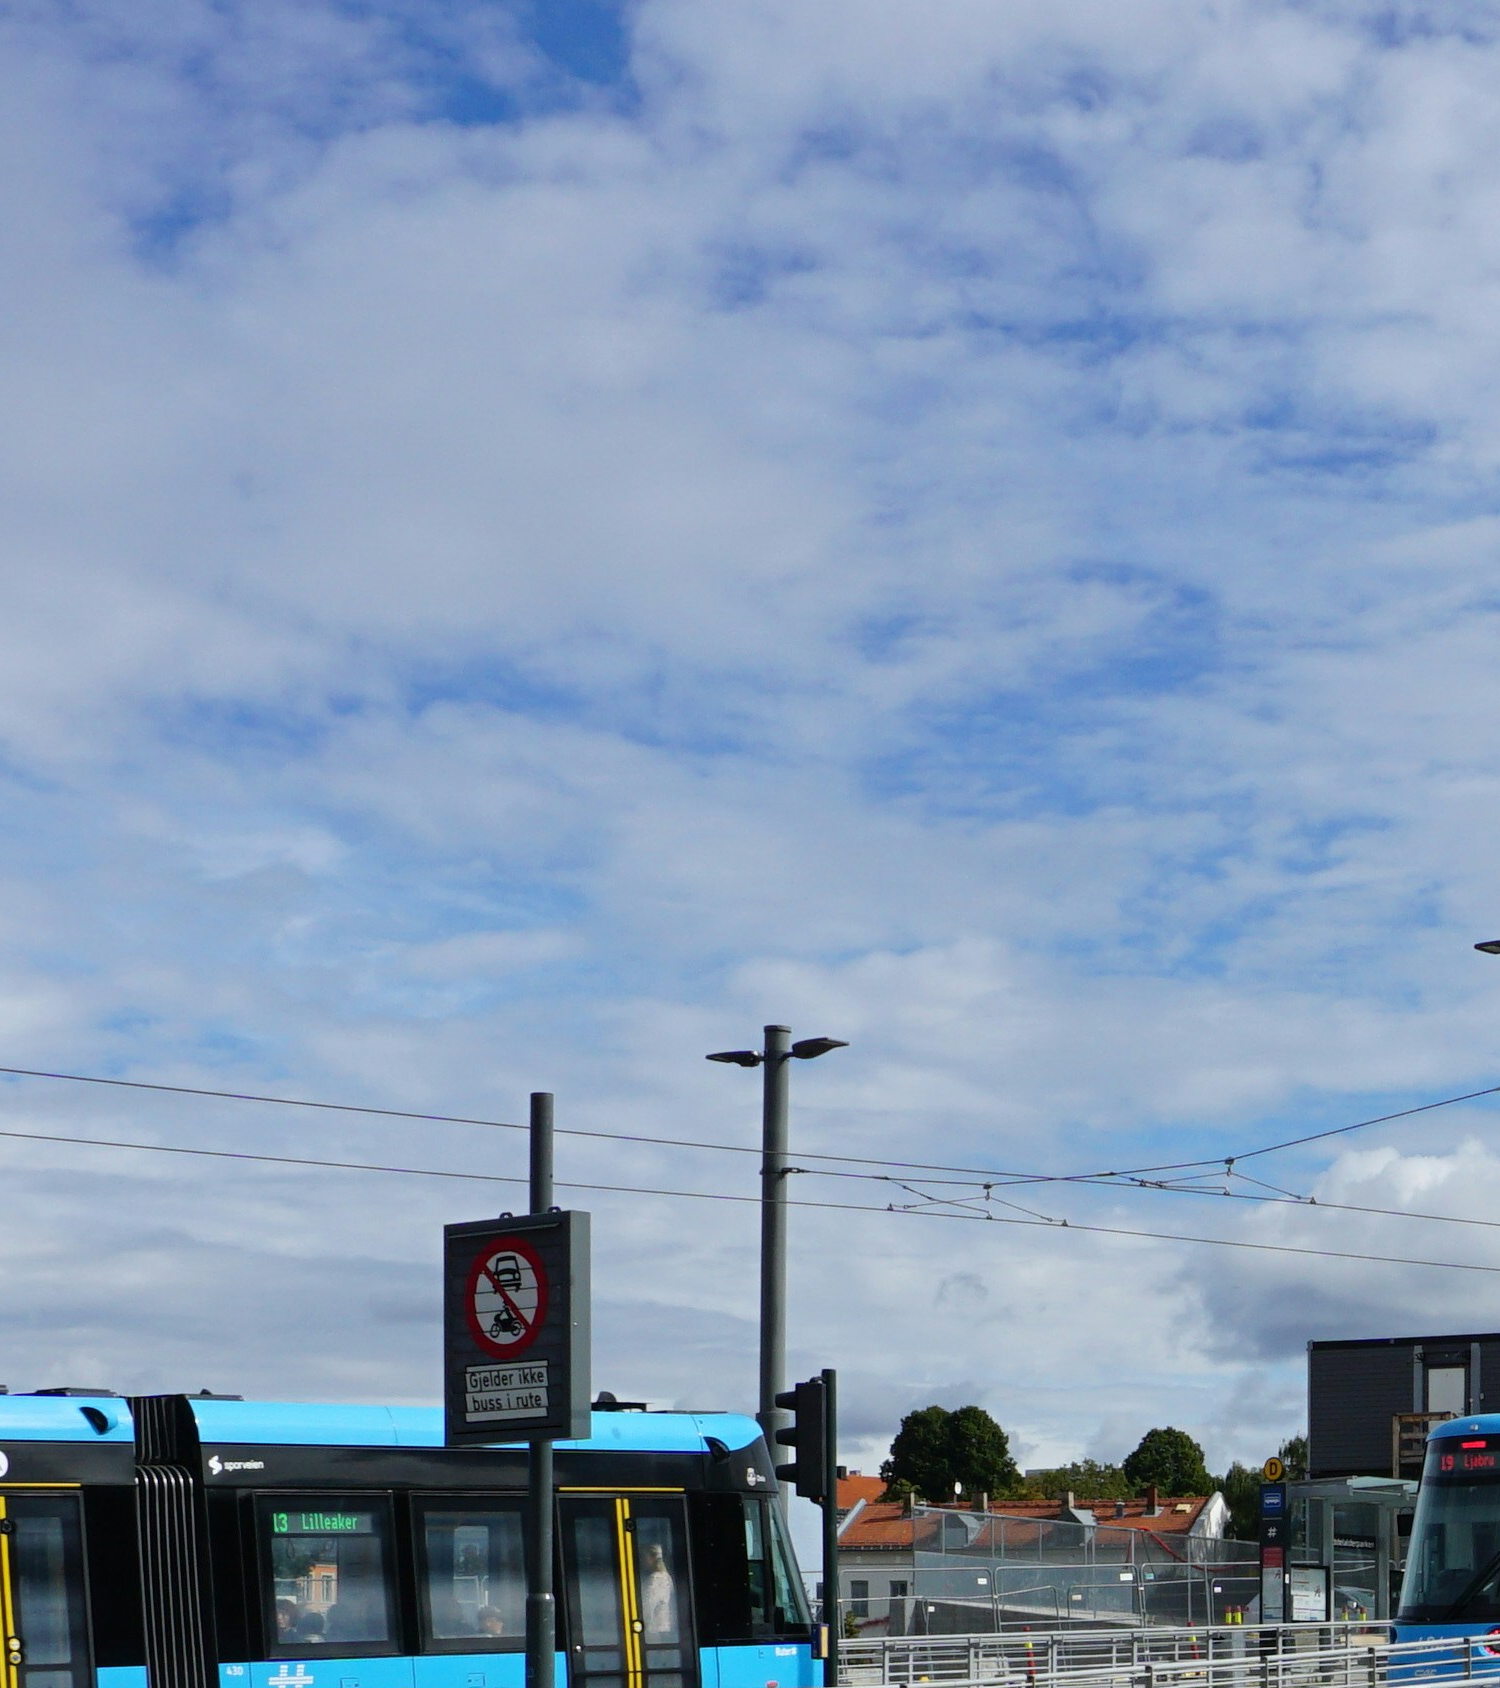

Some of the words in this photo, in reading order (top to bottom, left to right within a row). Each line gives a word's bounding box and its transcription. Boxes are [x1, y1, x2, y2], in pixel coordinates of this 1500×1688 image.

[469, 1371, 514, 1391] Gjelder
[518, 1367, 544, 1385] ikke
[472, 1395, 503, 1411] buss
[506, 1393, 511, 1408] i
[516, 1392, 542, 1409] rute
[224, 1460, 264, 1471] sporveien
[1269, 1462, 1278, 1476] D
[1441, 1456, 1454, 1471] 19
[273, 1513, 288, 1533] 13
[302, 1513, 357, 1531] Lilleaker
[226, 1666, 244, 1676] 430
